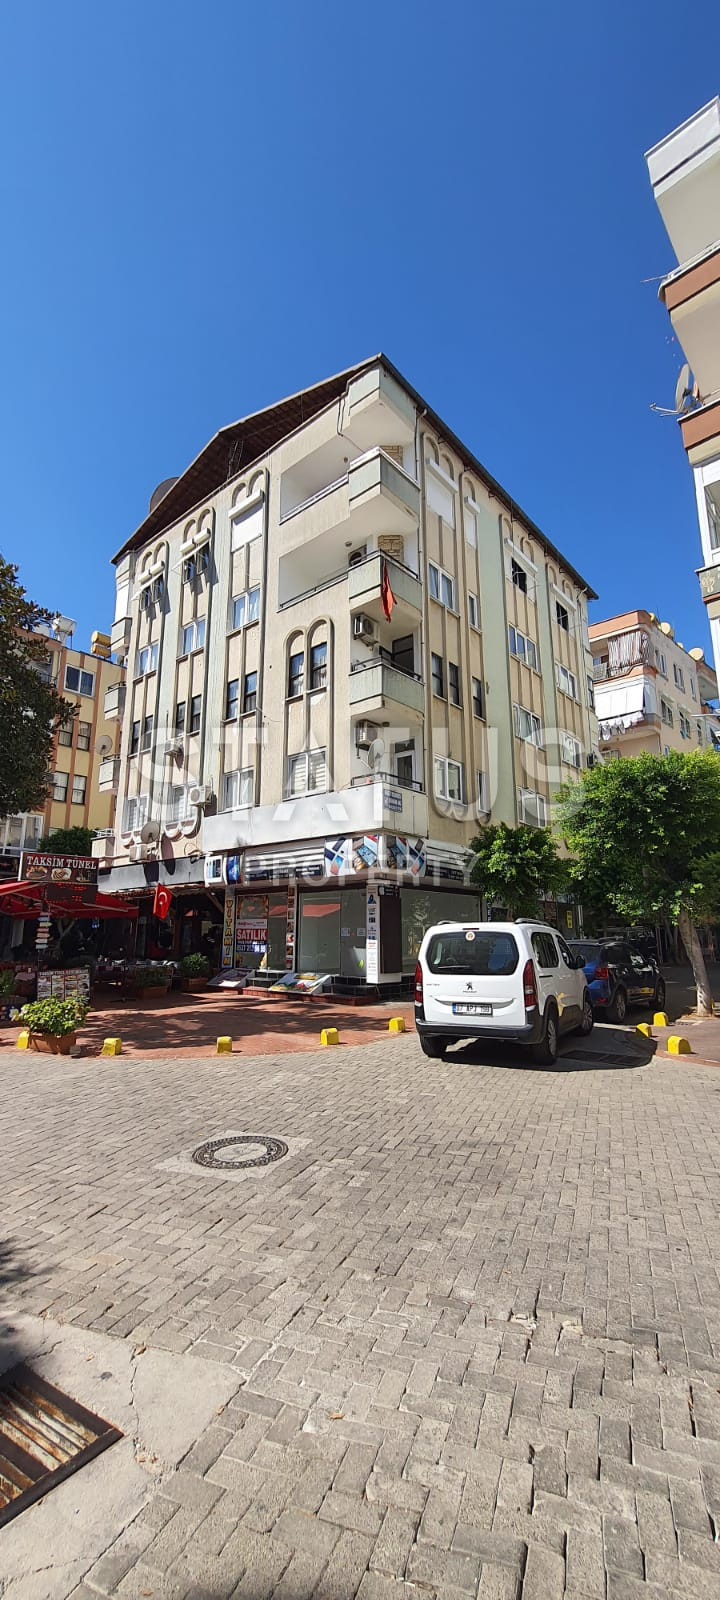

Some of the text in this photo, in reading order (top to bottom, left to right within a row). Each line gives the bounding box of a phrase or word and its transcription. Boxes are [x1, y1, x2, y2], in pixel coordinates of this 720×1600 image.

[27, 856, 96, 869] TAKSİM TÜNEL
[237, 929, 267, 941] SATILIK
